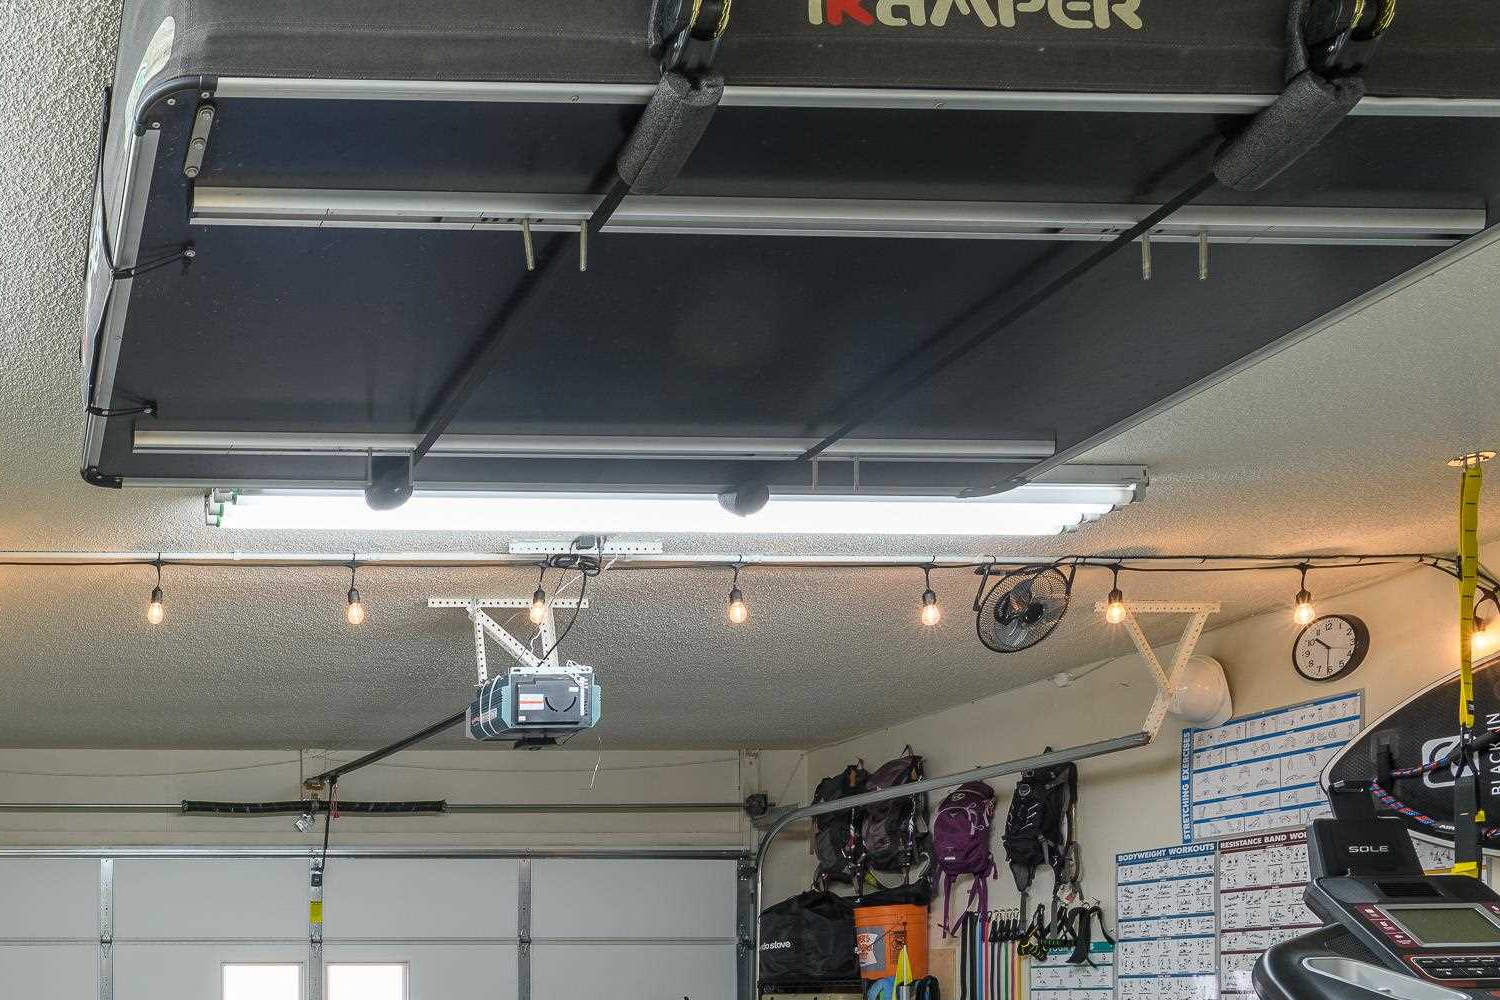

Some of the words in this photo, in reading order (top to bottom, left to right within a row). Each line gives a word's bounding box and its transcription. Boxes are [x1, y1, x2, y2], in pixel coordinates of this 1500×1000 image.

[1182, 732, 1191, 781] EXERCISES
[1182, 784, 1191, 840] STRETCHING
[1118, 849, 1167, 862] BODYWEIGHT
[1168, 843, 1215, 855] WORKOUTS
[1220, 837, 1262, 849] RESISTANCE
[1264, 833, 1287, 844] BAND
